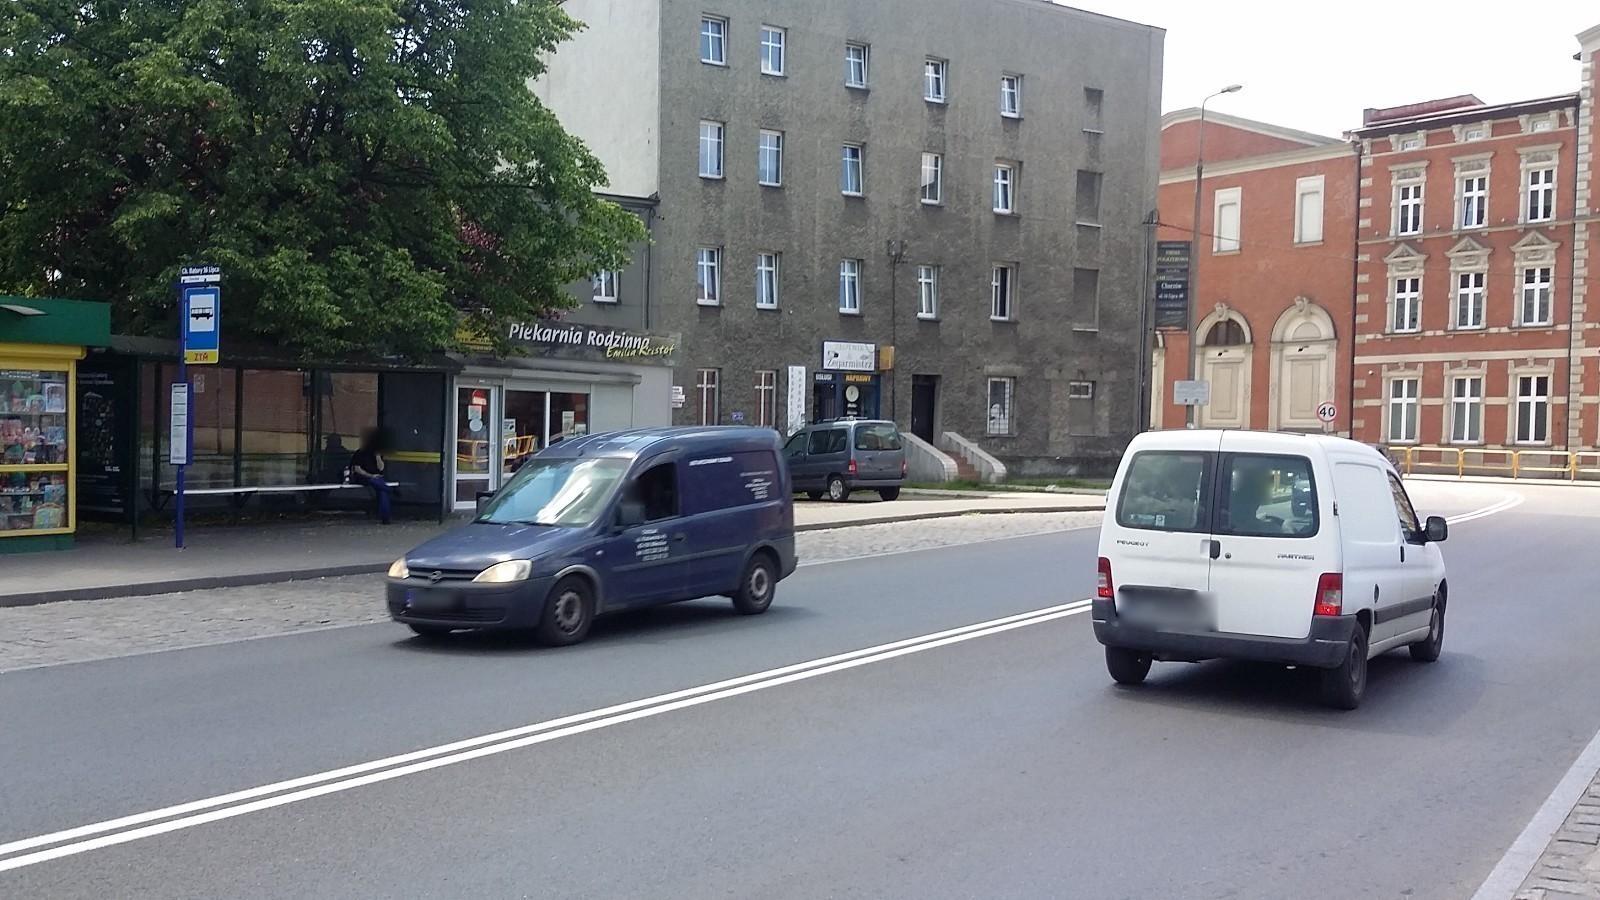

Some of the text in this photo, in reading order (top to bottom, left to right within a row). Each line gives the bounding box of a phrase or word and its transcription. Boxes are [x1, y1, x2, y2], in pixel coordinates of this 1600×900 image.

[509, 322, 583, 345] Piekarnia
[587, 330, 650, 350] Rodzinna
[606, 343, 675, 358] Emilia Kristof
[1319, 406, 1336, 418] 40
